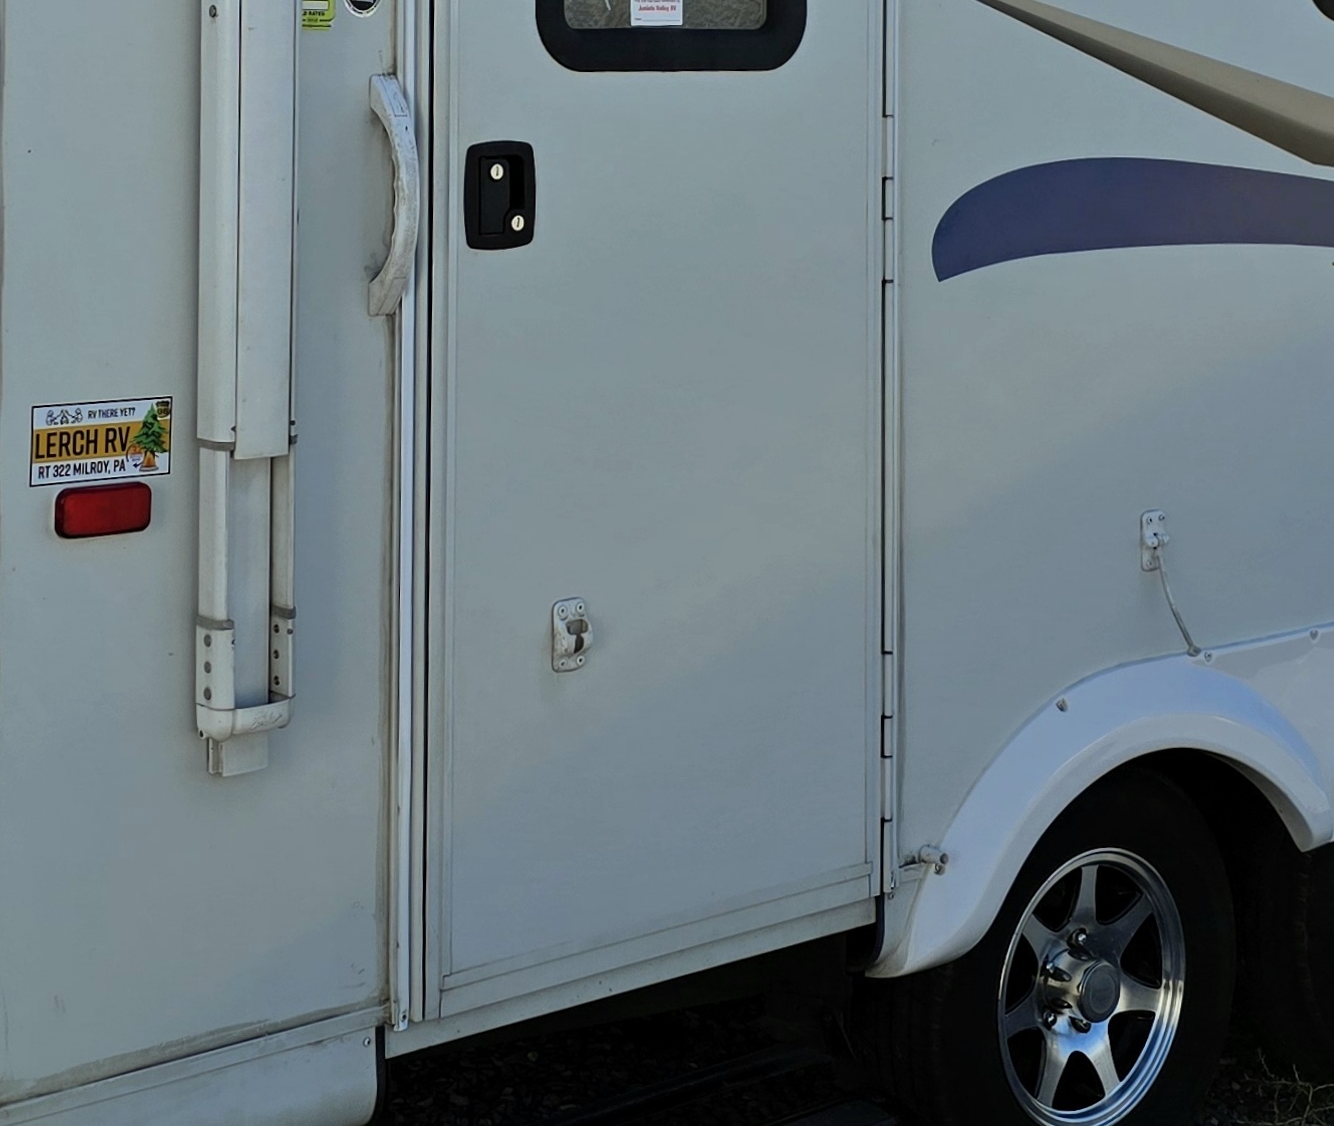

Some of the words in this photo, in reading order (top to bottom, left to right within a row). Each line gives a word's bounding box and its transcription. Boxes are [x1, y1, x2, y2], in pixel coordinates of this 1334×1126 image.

[88, 410, 97, 419] RV
[98, 409, 119, 418] THERE
[120, 407, 136, 417] YET?
[35, 428, 98, 459] LERCH
[104, 426, 131, 453] RV
[38, 466, 51, 479] RT
[53, 464, 71, 478] 322
[73, 460, 111, 476] MILROY,
[113, 459, 126, 473] PA
